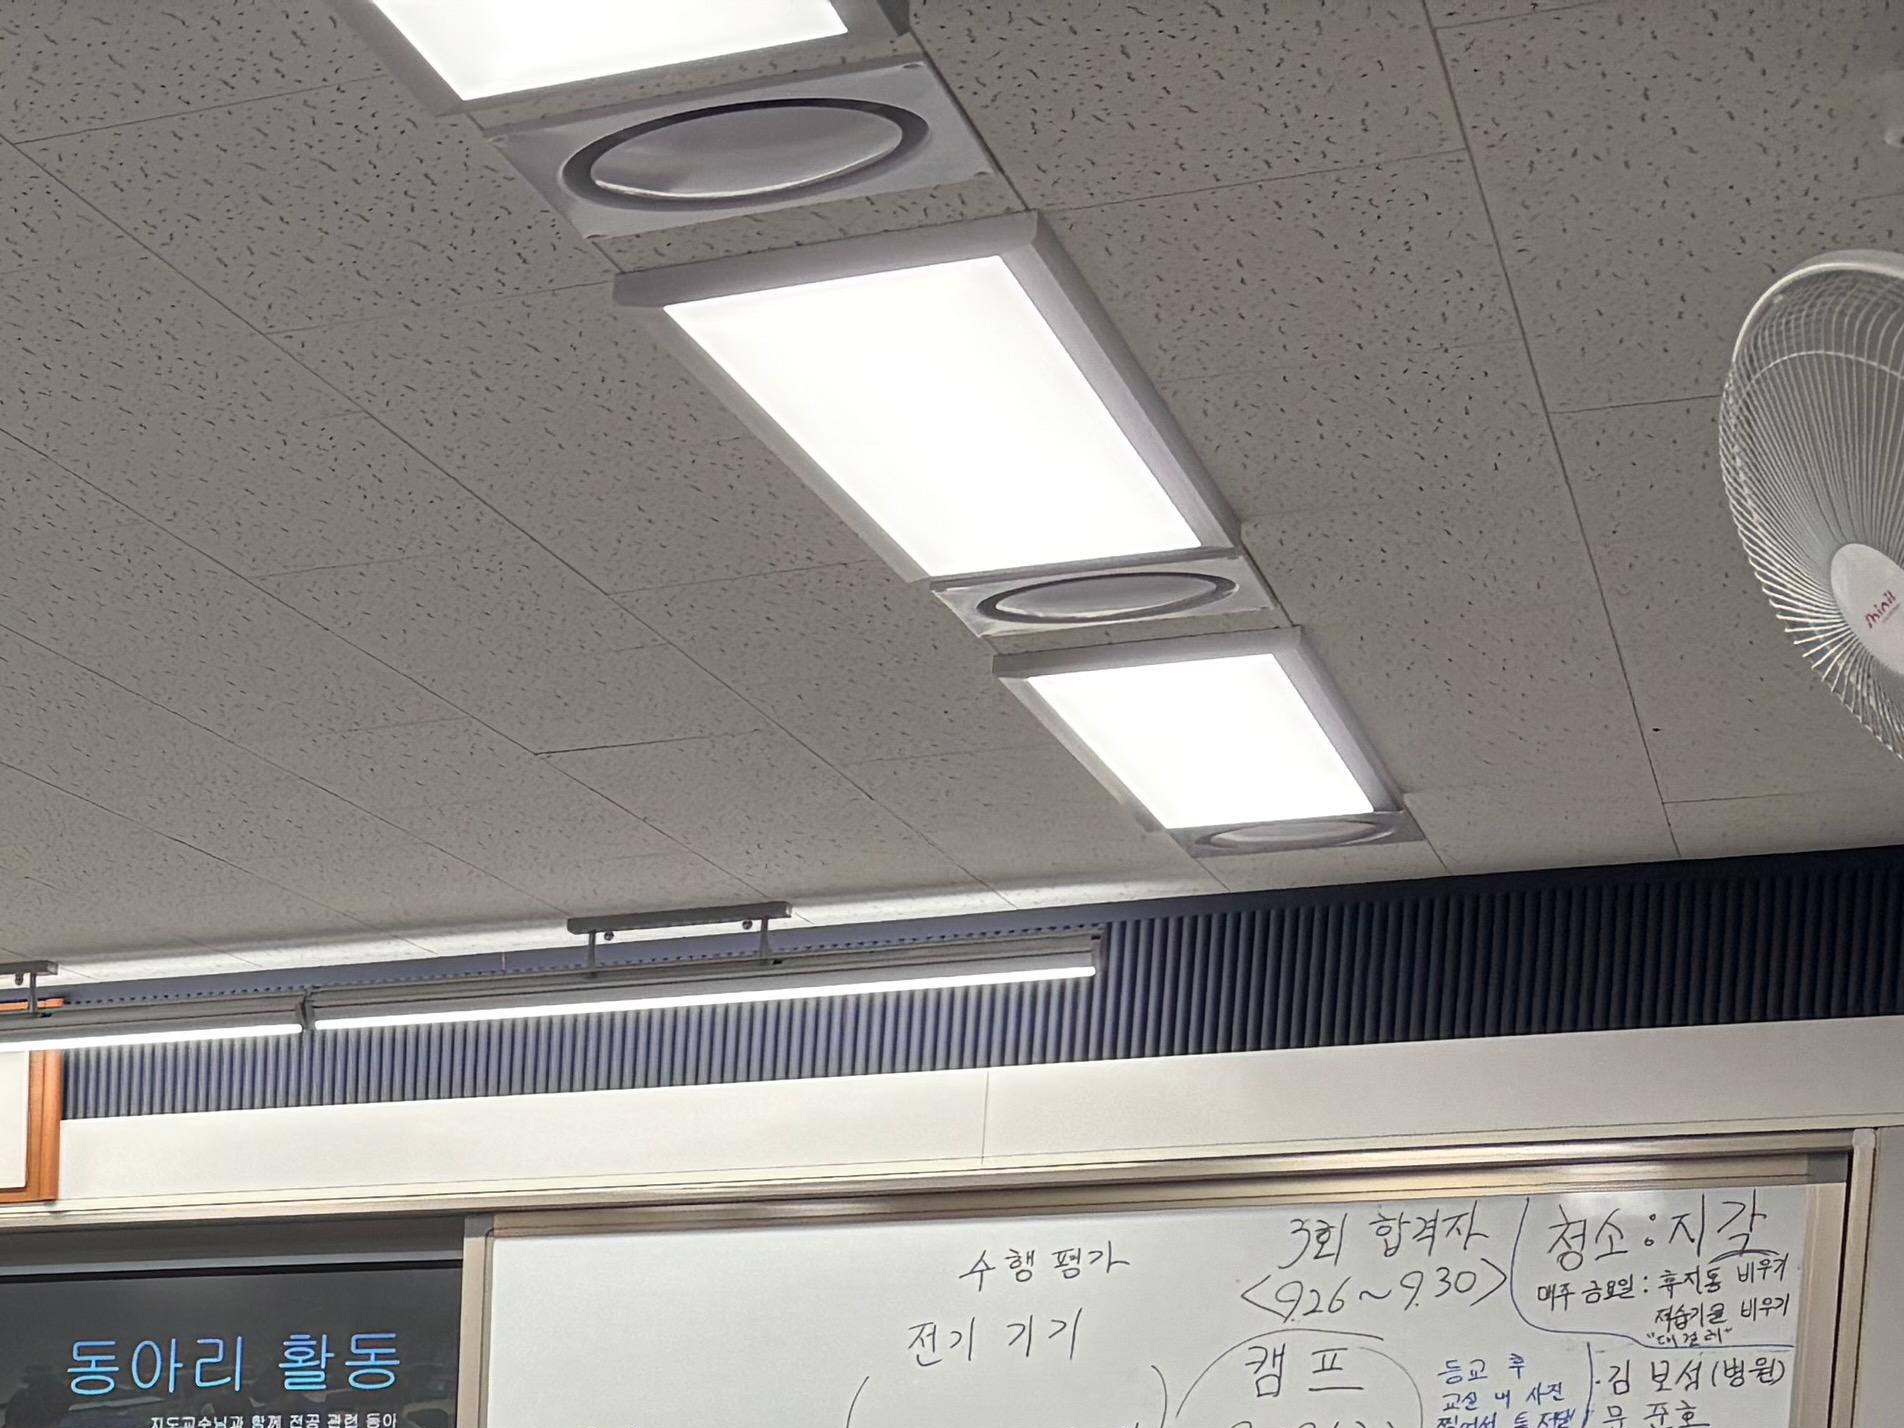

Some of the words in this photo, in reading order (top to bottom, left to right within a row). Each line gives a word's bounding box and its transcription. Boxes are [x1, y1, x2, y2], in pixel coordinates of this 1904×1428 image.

[1278, 1213, 1348, 1269] 3회
[1368, 1200, 1489, 1258] 합격자
[1737, 1252, 1789, 1283] 비우기
[1741, 1293, 1790, 1321] 비우기
[908, 1316, 976, 1367] 전기
[1006, 1307, 1083, 1361] 기기
[67, 1336, 244, 1395] 동아리
[278, 1332, 402, 1392] 활동
[1437, 1359, 1488, 1385] 등교
[1508, 1353, 1526, 1380] 후
[1608, 1359, 1631, 1395] 김
[1442, 1391, 1479, 1412] 교실
[1494, 1389, 1511, 1409] 내
[1525, 1381, 1565, 1406] 사진
